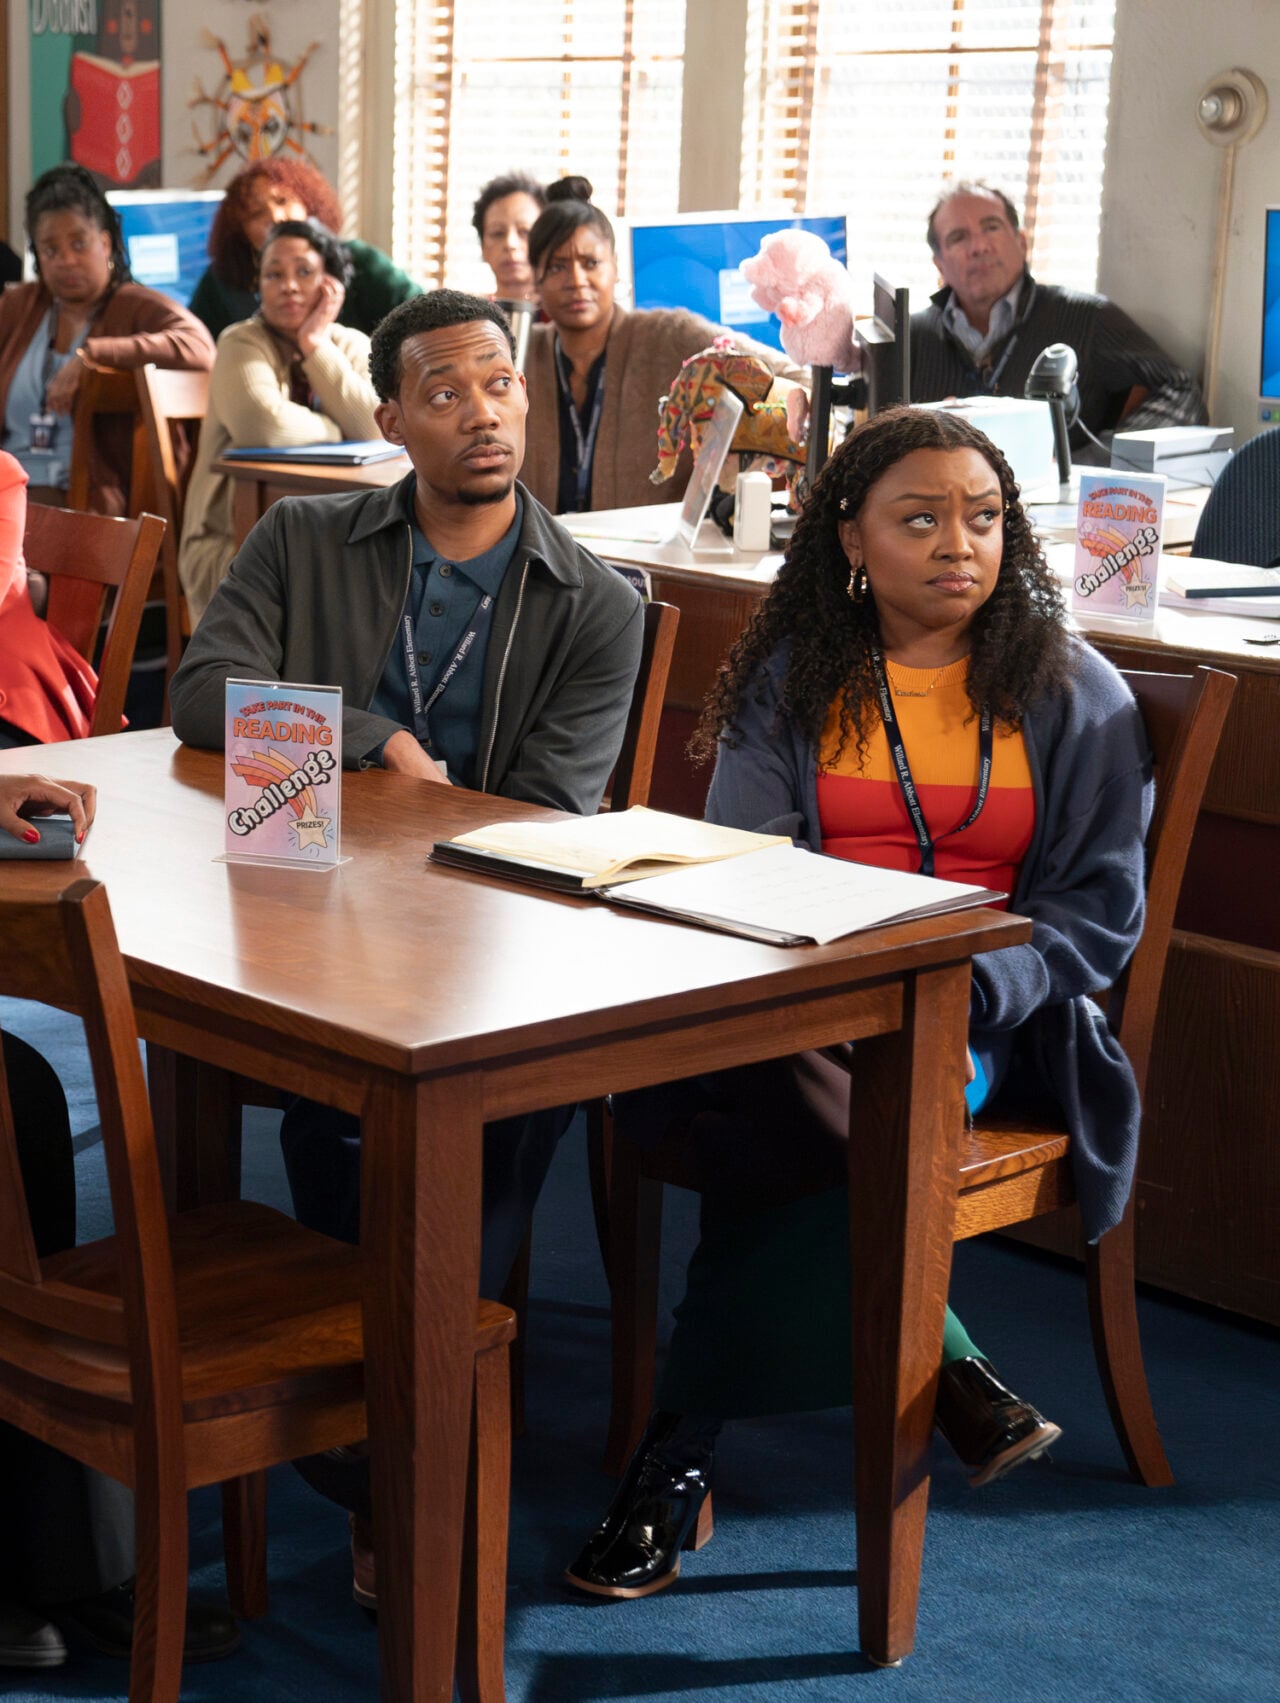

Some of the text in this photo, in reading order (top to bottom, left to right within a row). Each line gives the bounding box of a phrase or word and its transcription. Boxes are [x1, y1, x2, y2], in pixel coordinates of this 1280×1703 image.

[1089, 489, 1108, 500] TAKE
[1128, 490, 1137, 498] IN
[1083, 501, 1158, 524] READING
[1075, 527, 1159, 597] Challenge
[404, 614, 414, 653] Elementary
[458, 631, 476, 654] Willard
[408, 653, 418, 678] Abbott
[442, 661, 458, 683] Abbott
[240, 701, 326, 725] TAKE PART IN THE
[411, 687, 422, 714] Willard
[233, 718, 333, 746] READING
[979, 756, 992, 799] Elementary
[228, 749, 337, 836] Challenge
[894, 744, 929, 846] Willard R. Abbott Elementary
[296, 820, 325, 829] PRIZES!
